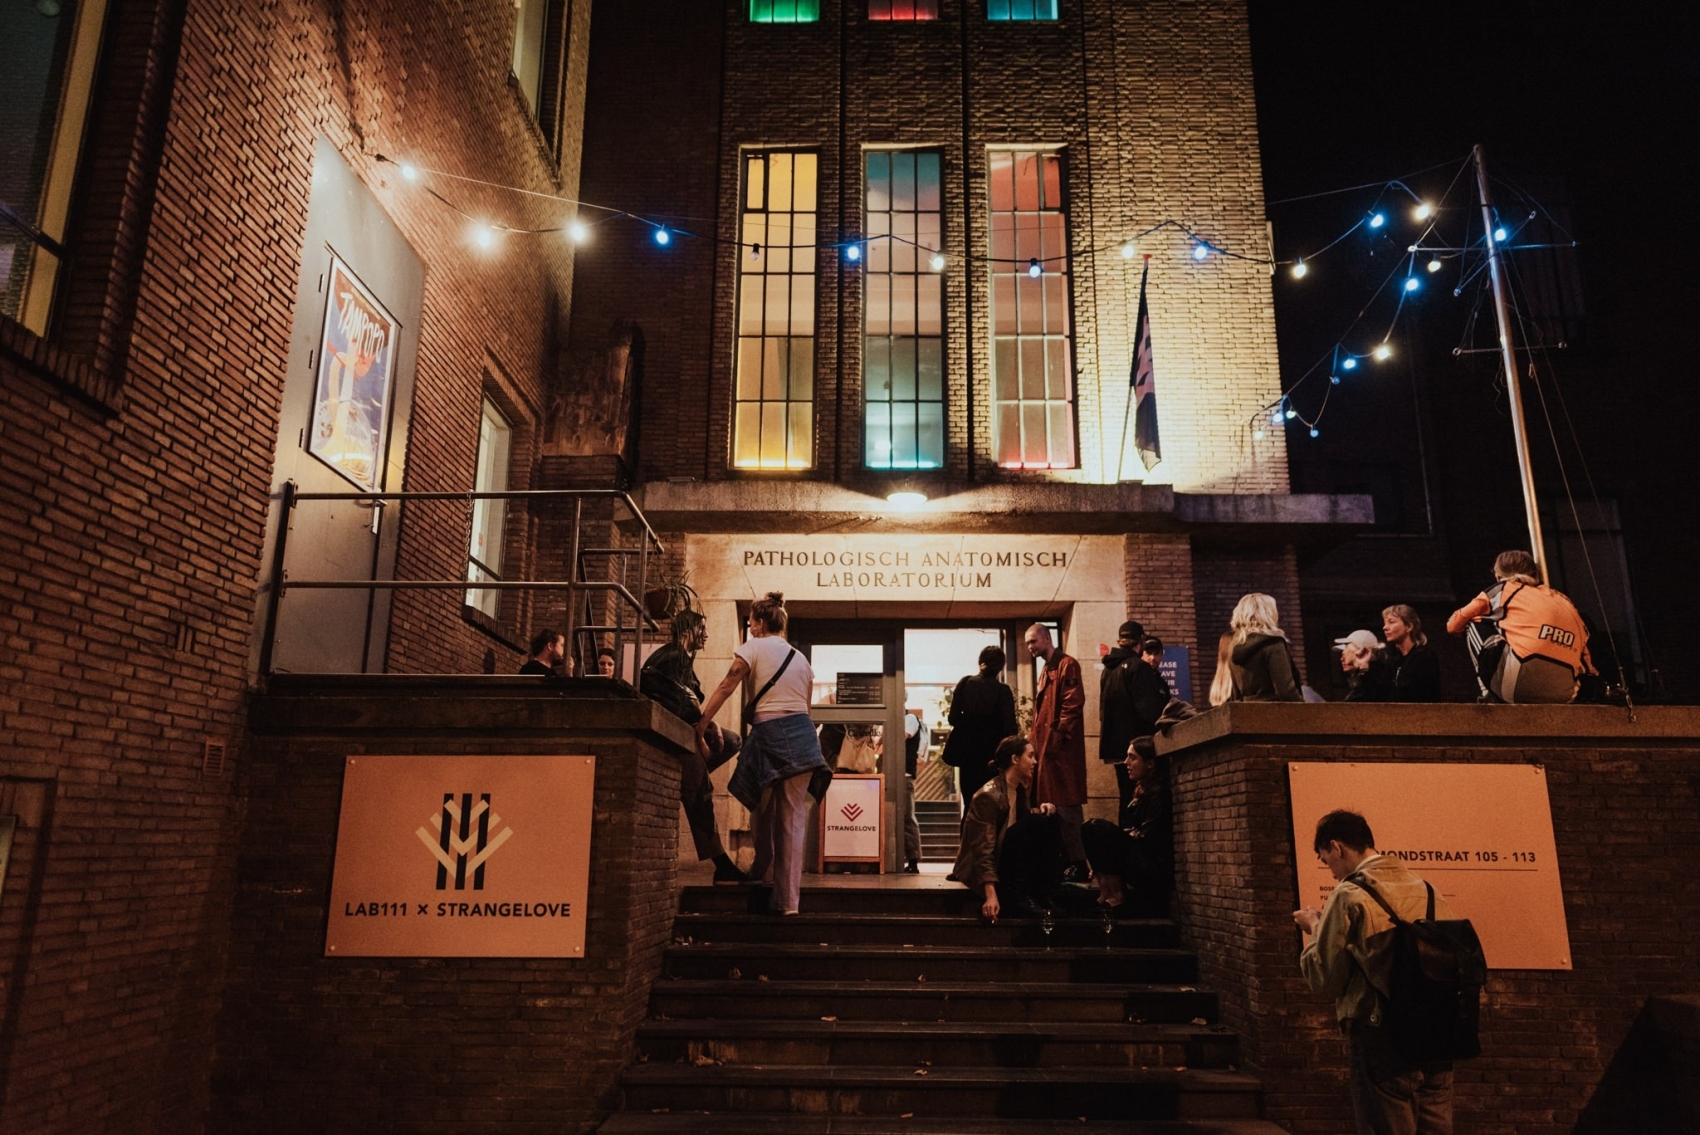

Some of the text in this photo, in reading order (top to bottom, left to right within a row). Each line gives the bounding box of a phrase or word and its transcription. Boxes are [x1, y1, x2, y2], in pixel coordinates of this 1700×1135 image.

[337, 292, 385, 364] TAMPOPO
[743, 550, 1067, 567] PATHOLOGISCH ANATOMISCH
[817, 572, 992, 588] LABORATORIUM
[1538, 624, 1575, 647] PRO
[1475, 851, 1498, 862] 105
[1512, 852, 1536, 862] 113
[345, 902, 407, 917] LAB111
[437, 902, 571, 917] STRANGELOVE
